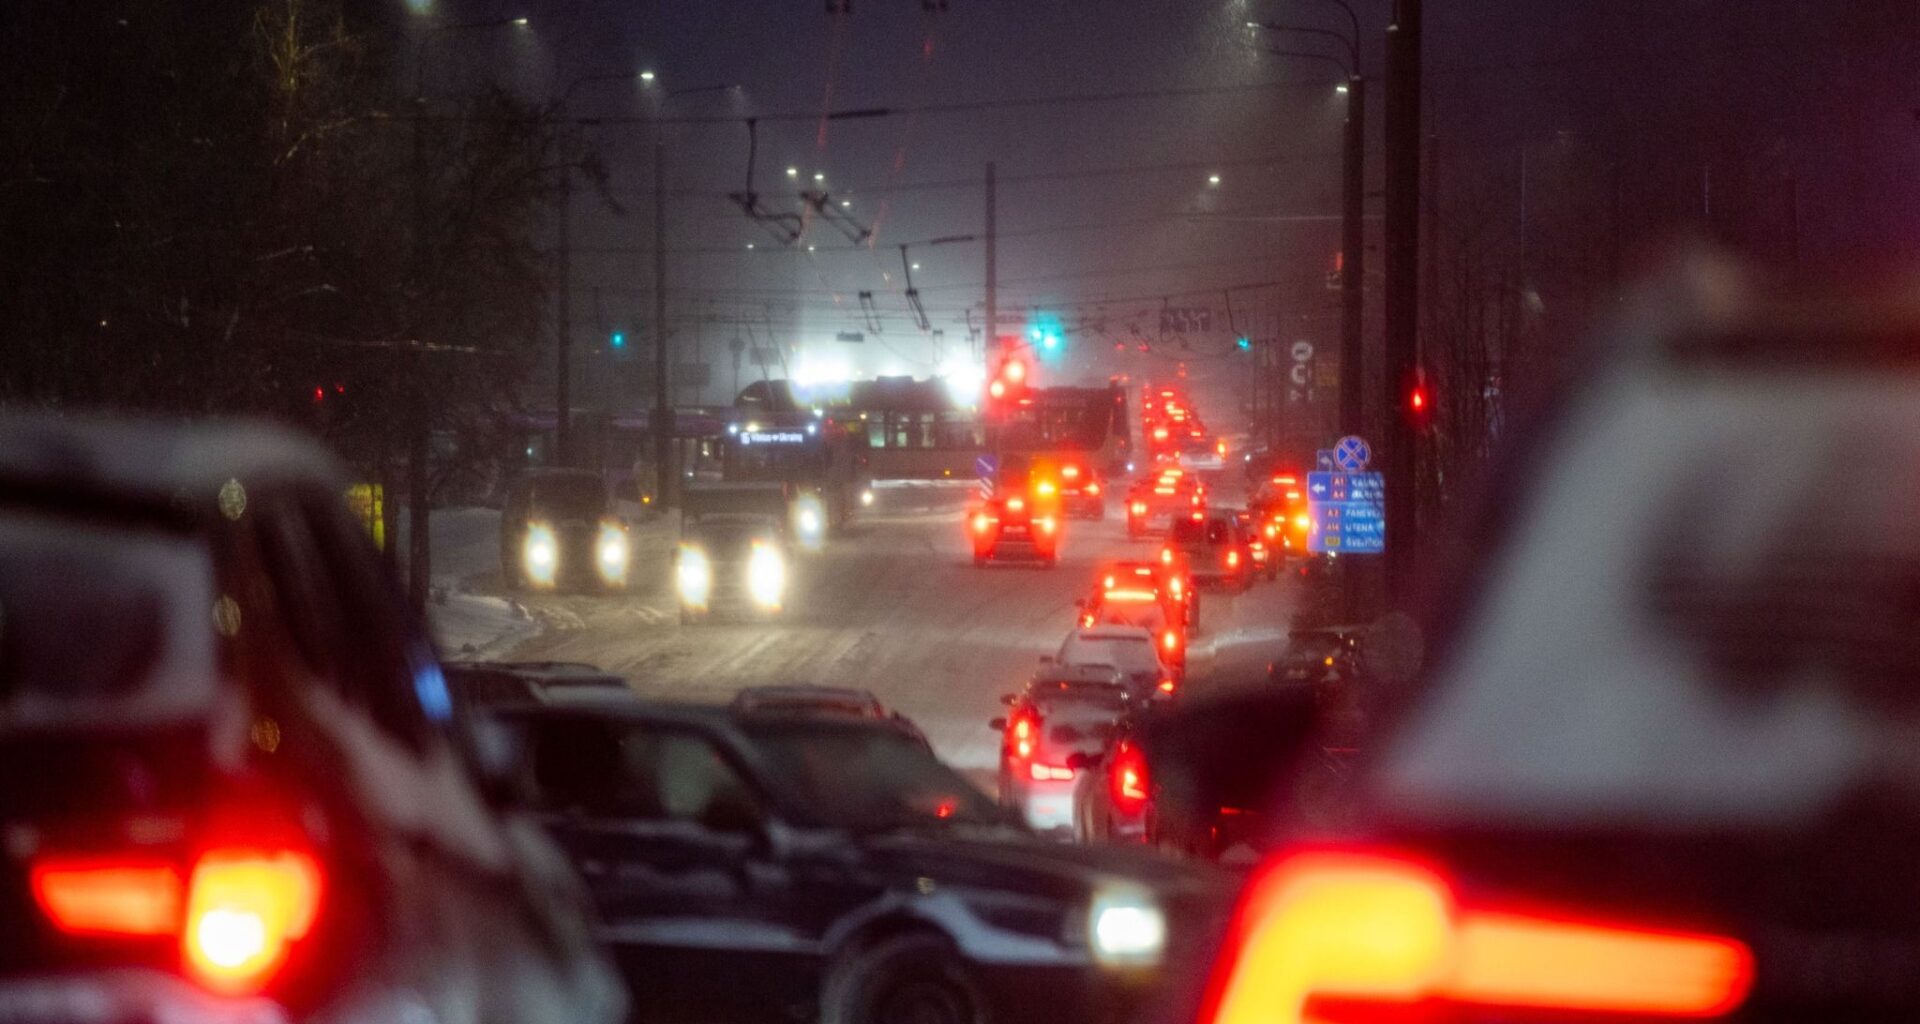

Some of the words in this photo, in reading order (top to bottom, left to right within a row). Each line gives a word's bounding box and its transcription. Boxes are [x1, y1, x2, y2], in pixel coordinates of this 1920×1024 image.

[1334, 477, 1344, 486] A1
[1333, 490, 1344, 498] A4
[1346, 522, 1375, 532] UTENA
